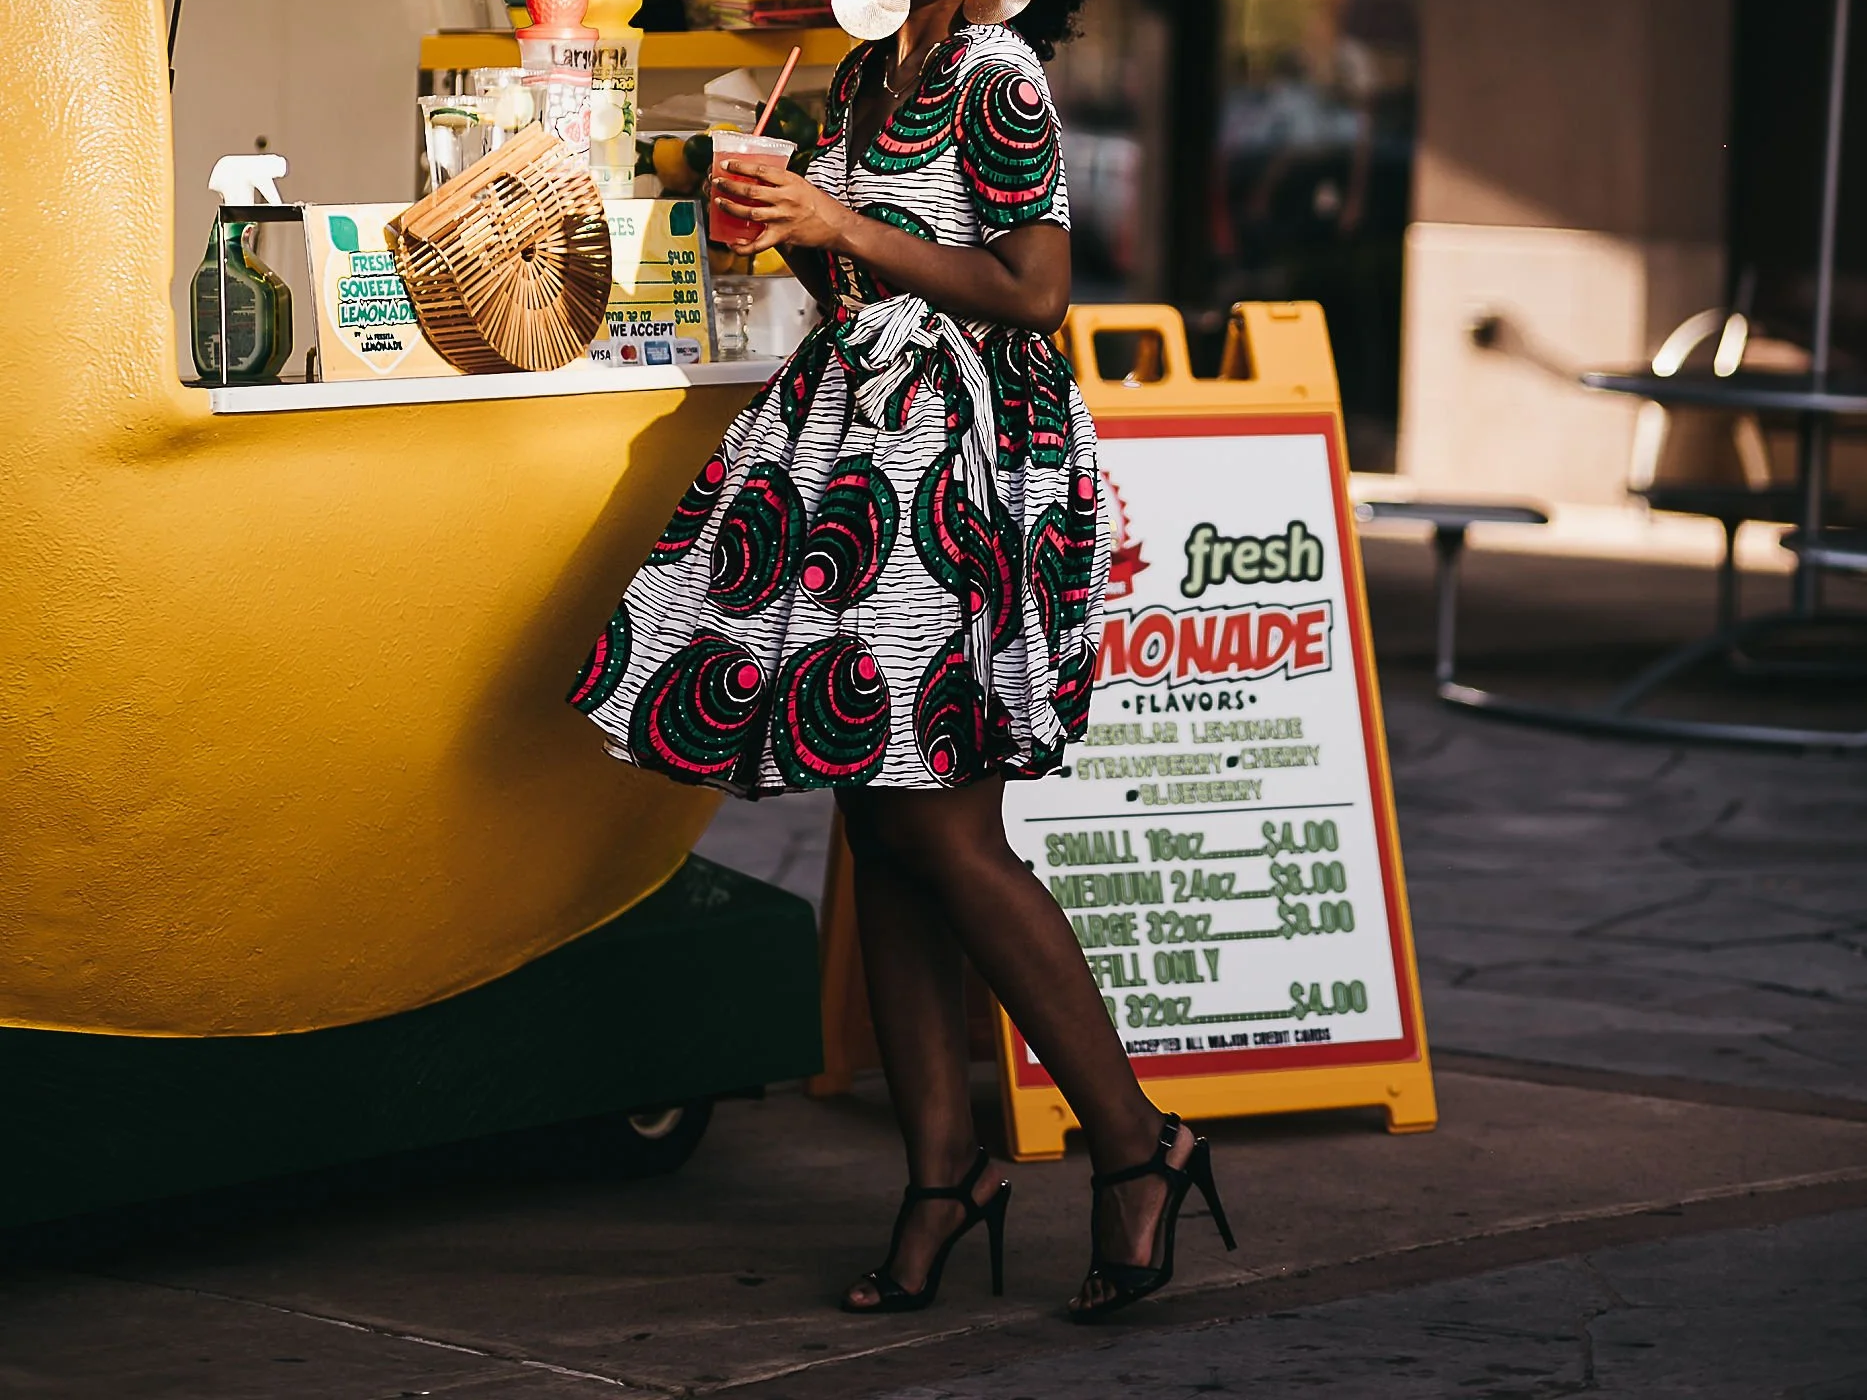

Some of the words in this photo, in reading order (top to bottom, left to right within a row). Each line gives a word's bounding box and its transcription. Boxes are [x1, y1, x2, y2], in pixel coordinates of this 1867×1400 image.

[352, 254, 394, 272] FRESH
[668, 250, 695, 265] $4.00
[339, 279, 405, 298] SQUEEZE
[671, 270, 697, 285] $6.00
[610, 323, 627, 337] WE
[631, 323, 674, 337] ACCEPT
[675, 310, 700, 325] $4.00
[361, 340, 403, 352] LEMONADE
[590, 349, 611, 361] VISA
[1180, 520, 1323, 598] fresh
[1094, 606, 1329, 685] MONADE
[1136, 690, 1244, 715] FLAVORS
[1191, 717, 1304, 744] LEMONADE
[1077, 753, 1222, 780] STRAWBERRY
[1241, 745, 1320, 770] CHERRY
[1140, 779, 1262, 806] BLUEBERRY
[1045, 829, 1139, 867] SMALL
[1262, 820, 1339, 859] $4.00
[1049, 870, 1164, 909] MEDIUM
[1170, 868, 1236, 903] 24oz
[1070, 912, 1140, 949] ARGE
[1146, 910, 1212, 945] 32oz
[1278, 900, 1355, 940] $8.00
[1085, 952, 1147, 989] FILL
[1154, 948, 1220, 985] ONLY
[1124, 993, 1193, 1029] 32oz
[1290, 979, 1368, 1021] $4.00
